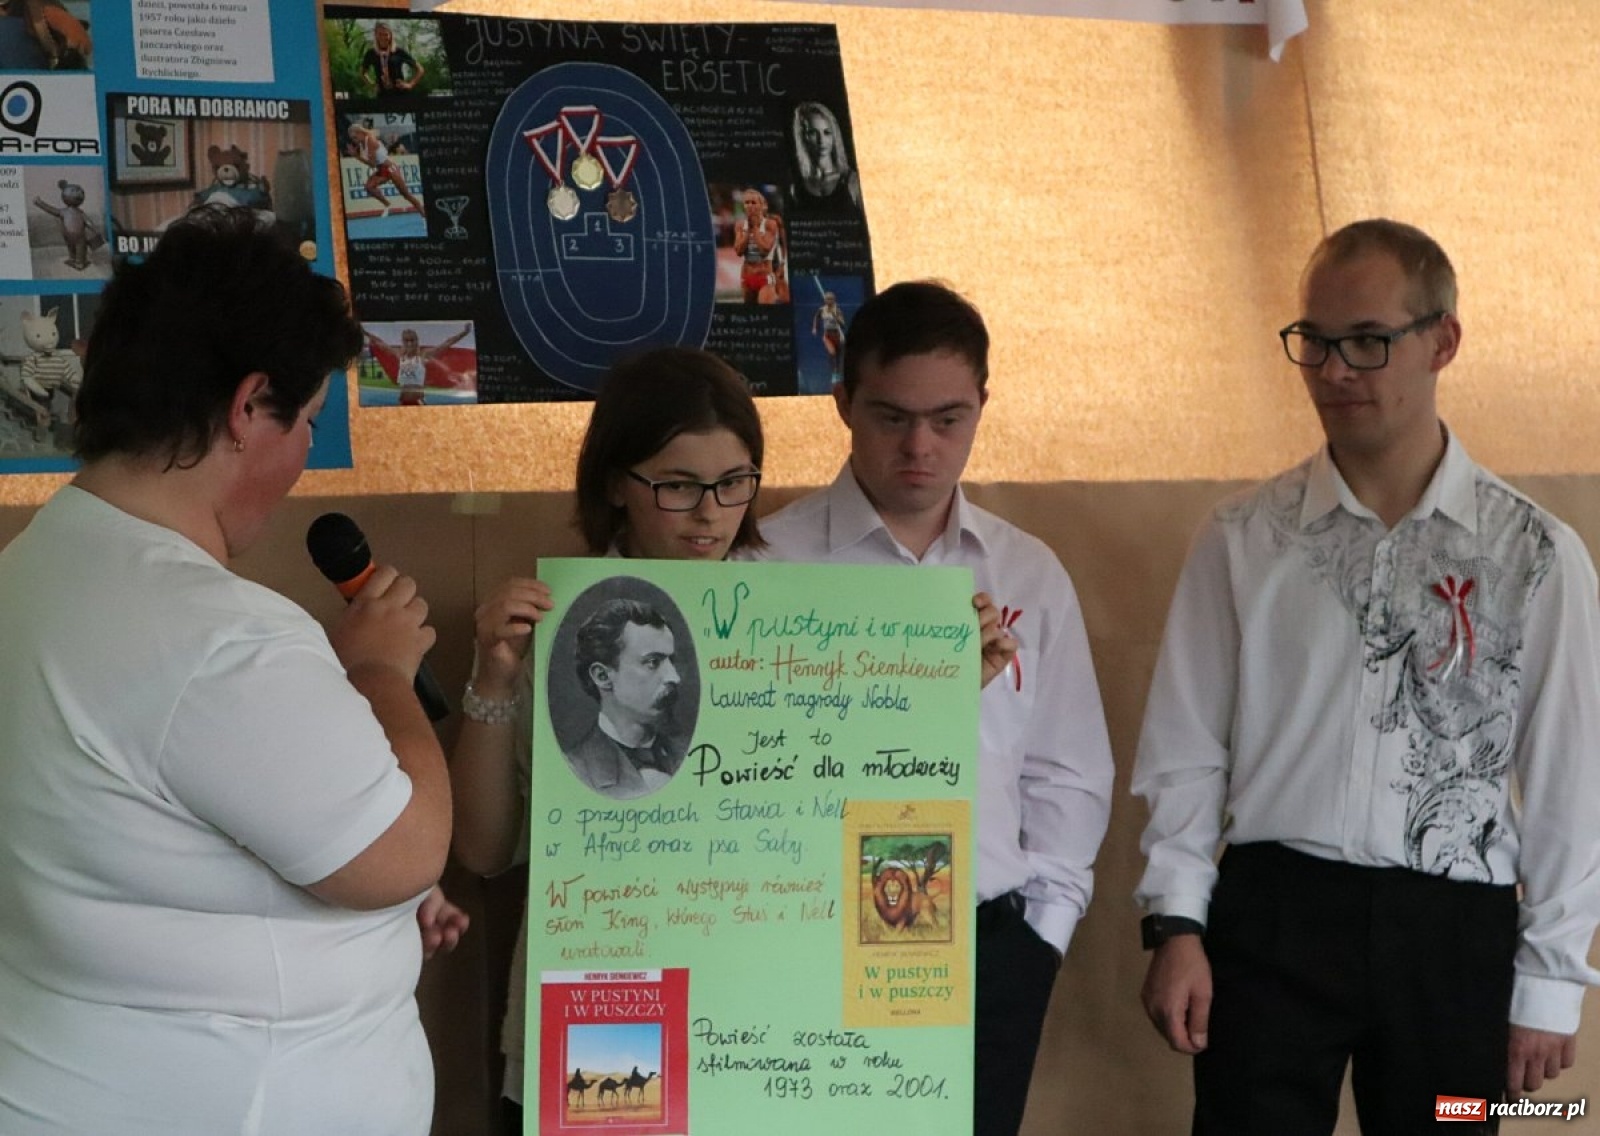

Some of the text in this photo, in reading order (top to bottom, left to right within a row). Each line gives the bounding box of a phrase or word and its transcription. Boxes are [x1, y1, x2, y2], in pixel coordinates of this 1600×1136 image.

[140, 13, 162, 21] 1957
[164, 14, 185, 23] roku
[187, 15, 206, 25] jako
[139, 28, 216, 38] pisarza Czesława
[464, 17, 605, 65] JUSTYNA
[140, 41, 224, 52] Janczarskiego oraz
[140, 54, 237, 66] ilustratora Zbigniewa
[661, 59, 787, 97] ERSETIC
[127, 96, 289, 119] PORA NA DOBRANOC
[593, 220, 602, 232] 1
[656, 231, 697, 239] START
[117, 235, 141, 253] BO
[569, 239, 625, 253] 2 3
[747, 608, 858, 656] pustyni
[866, 616, 877, 637] i
[882, 621, 901, 636] w
[902, 622, 973, 653] puszczy
[709, 643, 961, 690] autor: Henryk Sienkiewicz
[783, 681, 853, 720] nagrody
[861, 684, 912, 713] Nobla
[741, 727, 832, 755] Jest to
[687, 743, 961, 787] Powieść dla młodzieży
[575, 802, 700, 837] przygodach
[715, 798, 786, 822] Stasia
[795, 799, 804, 819] i
[811, 789, 851, 820] Nell
[545, 843, 561, 857] w
[584, 832, 641, 863] Afryce
[647, 837, 694, 854] oraz
[708, 840, 740, 866] psa
[545, 873, 585, 909] W
[583, 876, 660, 914] powieści
[759, 872, 828, 895] również
[666, 904, 718, 938] którego
[776, 903, 789, 921] i
[800, 897, 837, 923] Nell
[584, 971, 648, 981] HENRYK SIENKIEWICZ
[864, 962, 950, 984] W pustyni
[570, 988, 661, 1003] W PUSTYNI
[858, 984, 955, 1002] i w puszczy
[564, 1003, 667, 1018] I W PUSZCZY
[692, 1017, 871, 1050] Powieść została
[830, 1057, 847, 1069] w
[863, 1050, 904, 1070] roku
[763, 1075, 814, 1099] 1973
[828, 1081, 873, 1098] oraz
